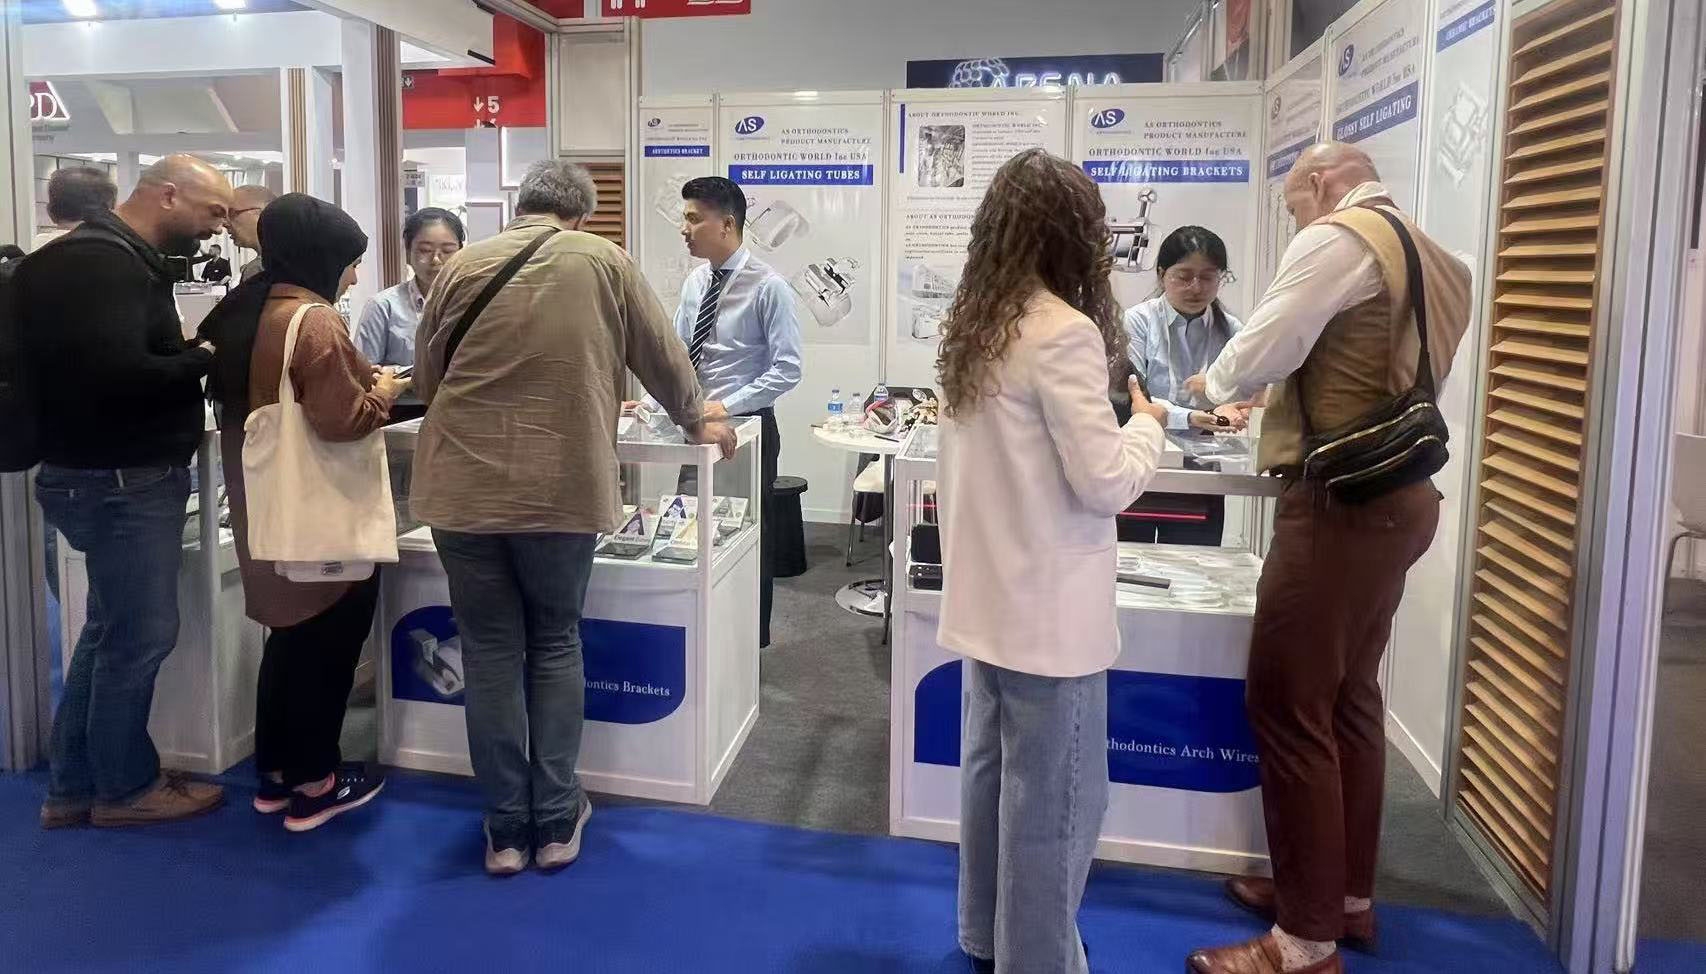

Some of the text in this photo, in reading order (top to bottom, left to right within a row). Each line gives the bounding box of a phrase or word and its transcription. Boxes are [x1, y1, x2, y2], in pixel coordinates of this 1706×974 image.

[487, 95, 500, 114] 5
[1359, 112, 1374, 131] SELF
[1375, 94, 1412, 123] LIGATING
[734, 152, 798, 161] ORTHODONTIC
[800, 152, 832, 160] WORLD
[850, 151, 867, 160] USA
[1088, 148, 1162, 157] ORTHODONTIC
[1165, 148, 1202, 156] WORLD
[741, 169, 860, 180] SELF LIGATING TUBES
[1183, 166, 1243, 176] BRACKETS
[622, 680, 671, 697] Brackets
[1180, 744, 1214, 760] Arch
